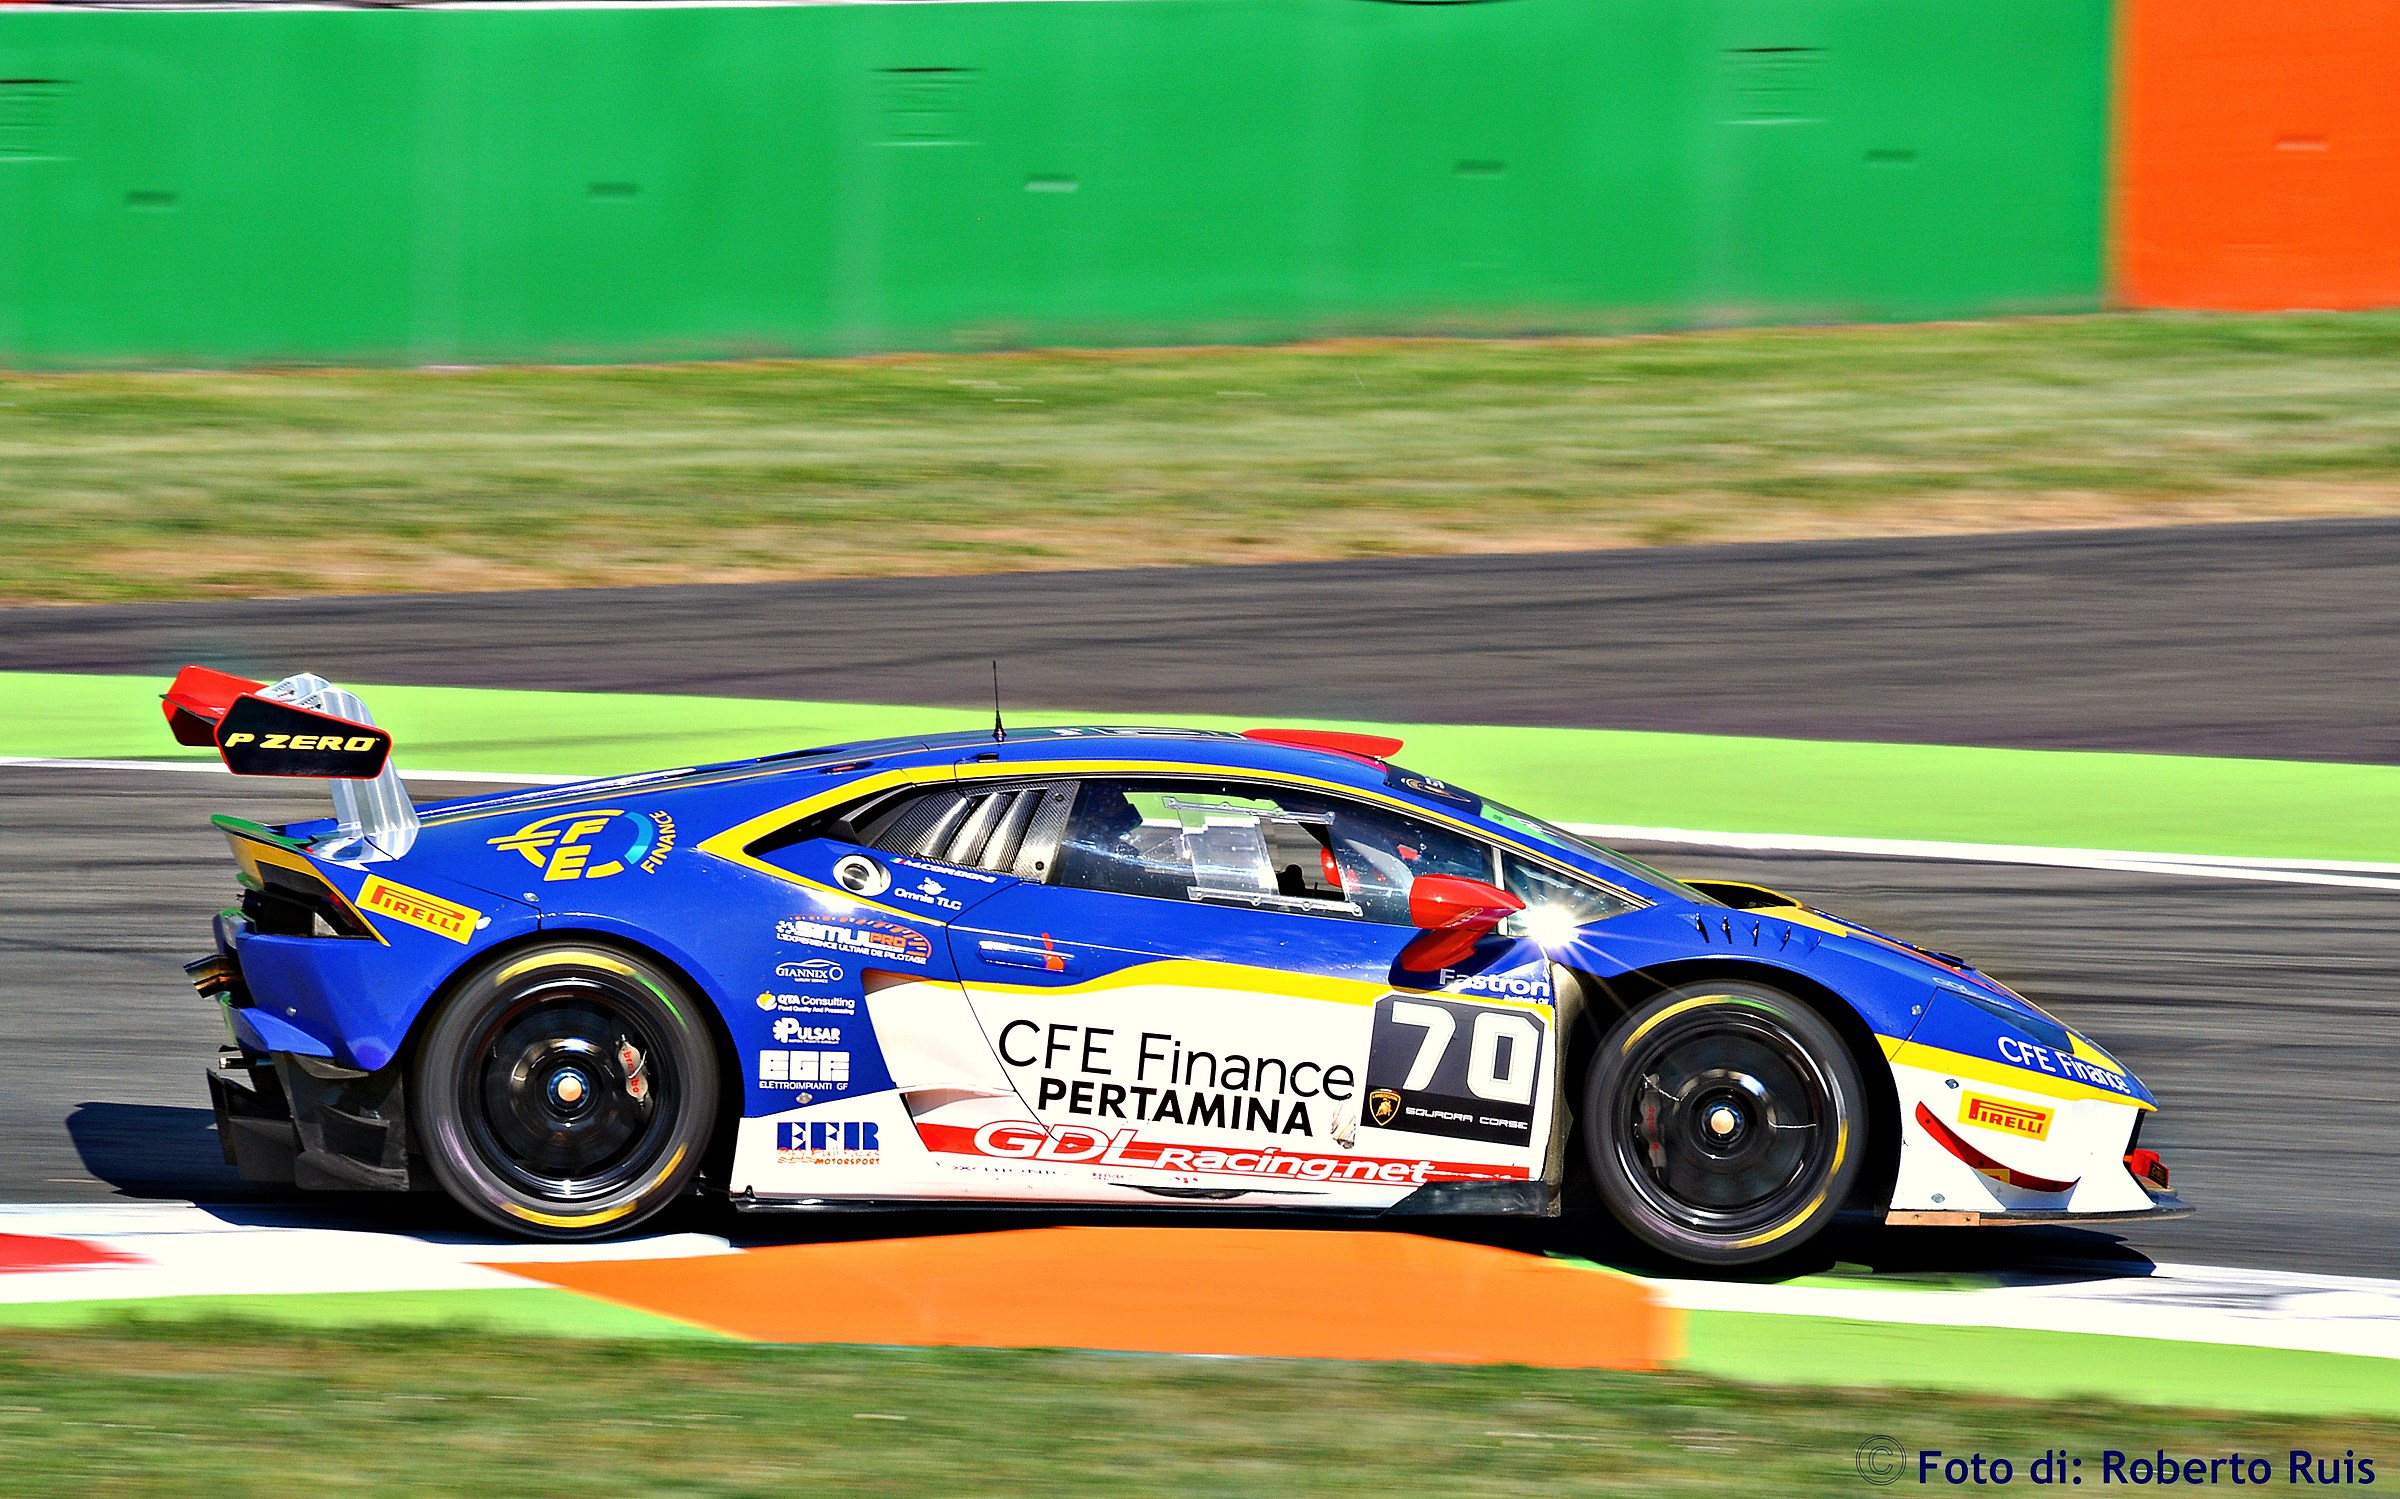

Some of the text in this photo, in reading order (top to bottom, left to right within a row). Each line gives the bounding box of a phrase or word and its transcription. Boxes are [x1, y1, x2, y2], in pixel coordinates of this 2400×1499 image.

[224, 732, 377, 752] P ZERO
[639, 809, 678, 876] FINANCE
[370, 885, 466, 933] PIRELLI
[893, 887, 963, 912] Omnis TLC
[870, 949, 883, 958] DE
[884, 952, 927, 965] PILOTAGE
[1439, 967, 1550, 997] Fastron
[777, 994, 856, 1009] QTA Consulting
[998, 1019, 1356, 1101] CFE Finance
[1391, 1001, 1540, 1106] 70
[1997, 1036, 2131, 1095] CFE Finance
[623, 1050, 640, 1094] brebo
[758, 1081, 849, 1091] ELETTROIMPIANTI GF
[1037, 1077, 1314, 1137] PERTAMINA
[1405, 1107, 1529, 1130] SQUADRA CORSE
[1968, 1098, 2047, 1134] PIRELLI
